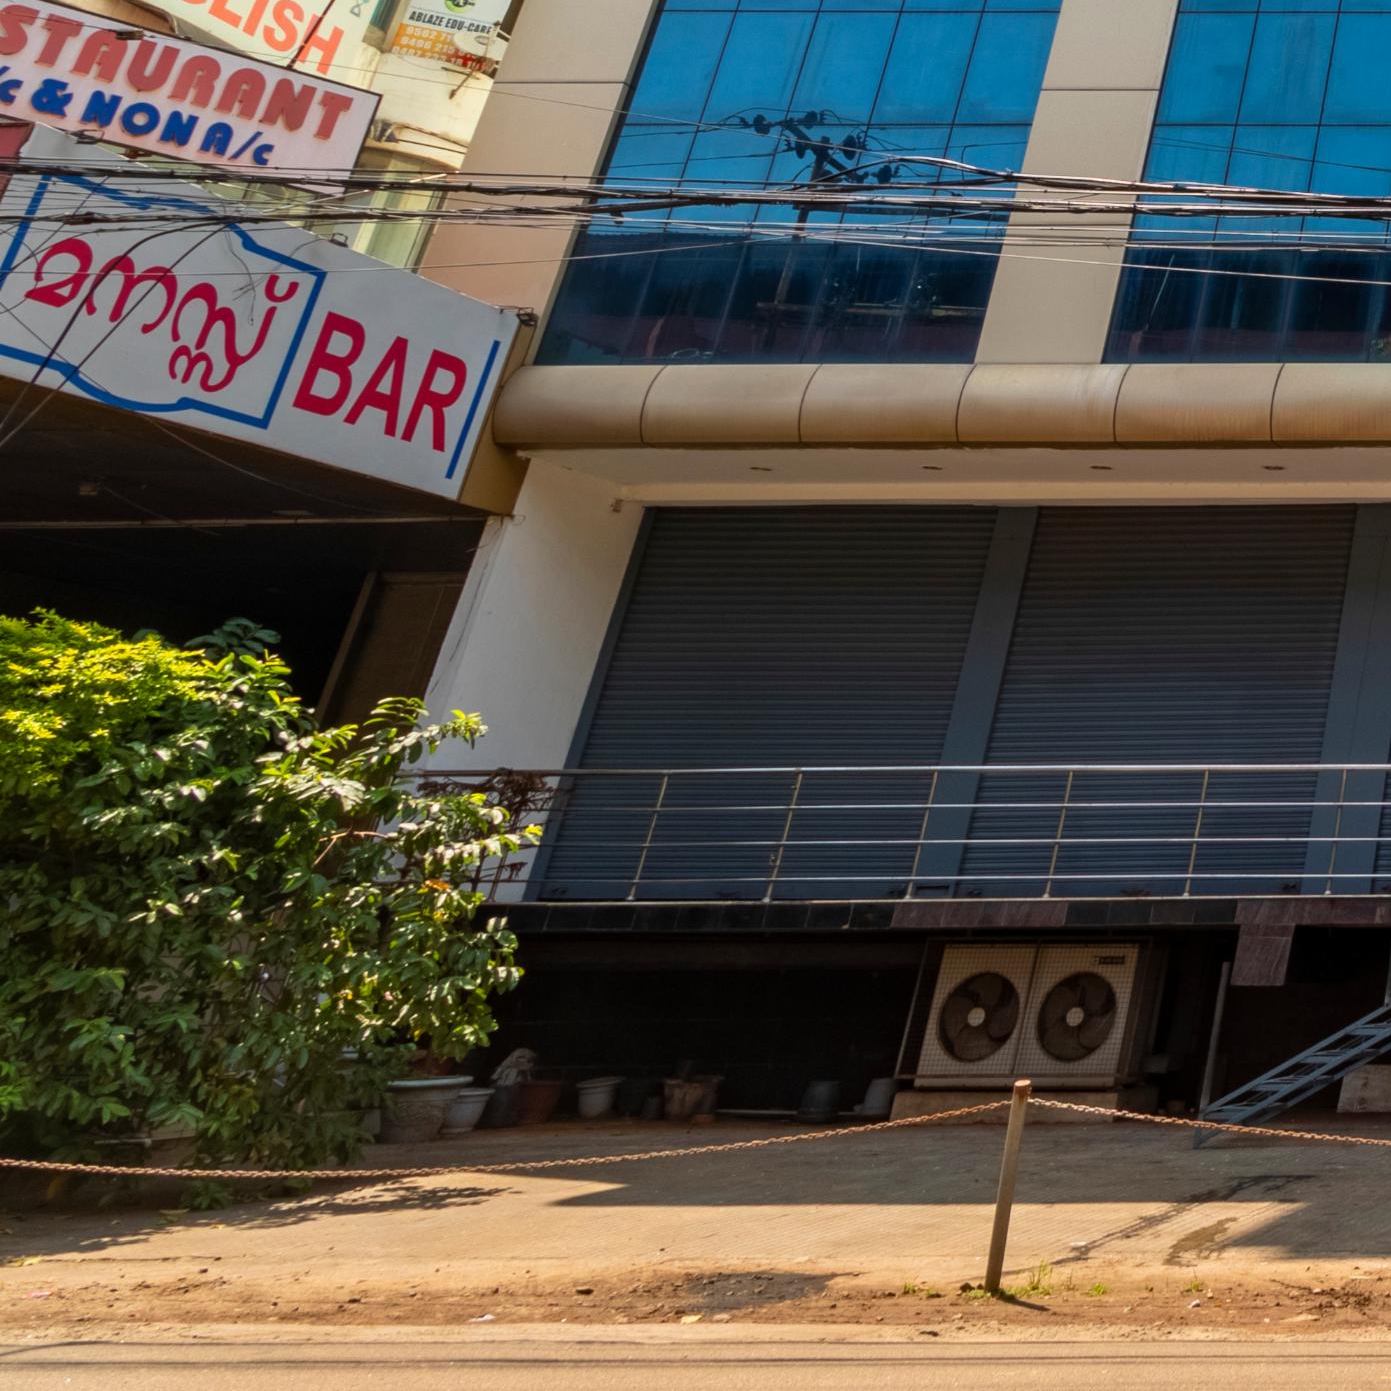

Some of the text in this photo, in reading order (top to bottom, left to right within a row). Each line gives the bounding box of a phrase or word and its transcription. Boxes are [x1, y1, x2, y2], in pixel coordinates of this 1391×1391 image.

[408, 10, 443, 28] ABLAZE
[31, 78, 73, 117] &
[292, 310, 468, 452] BAR
